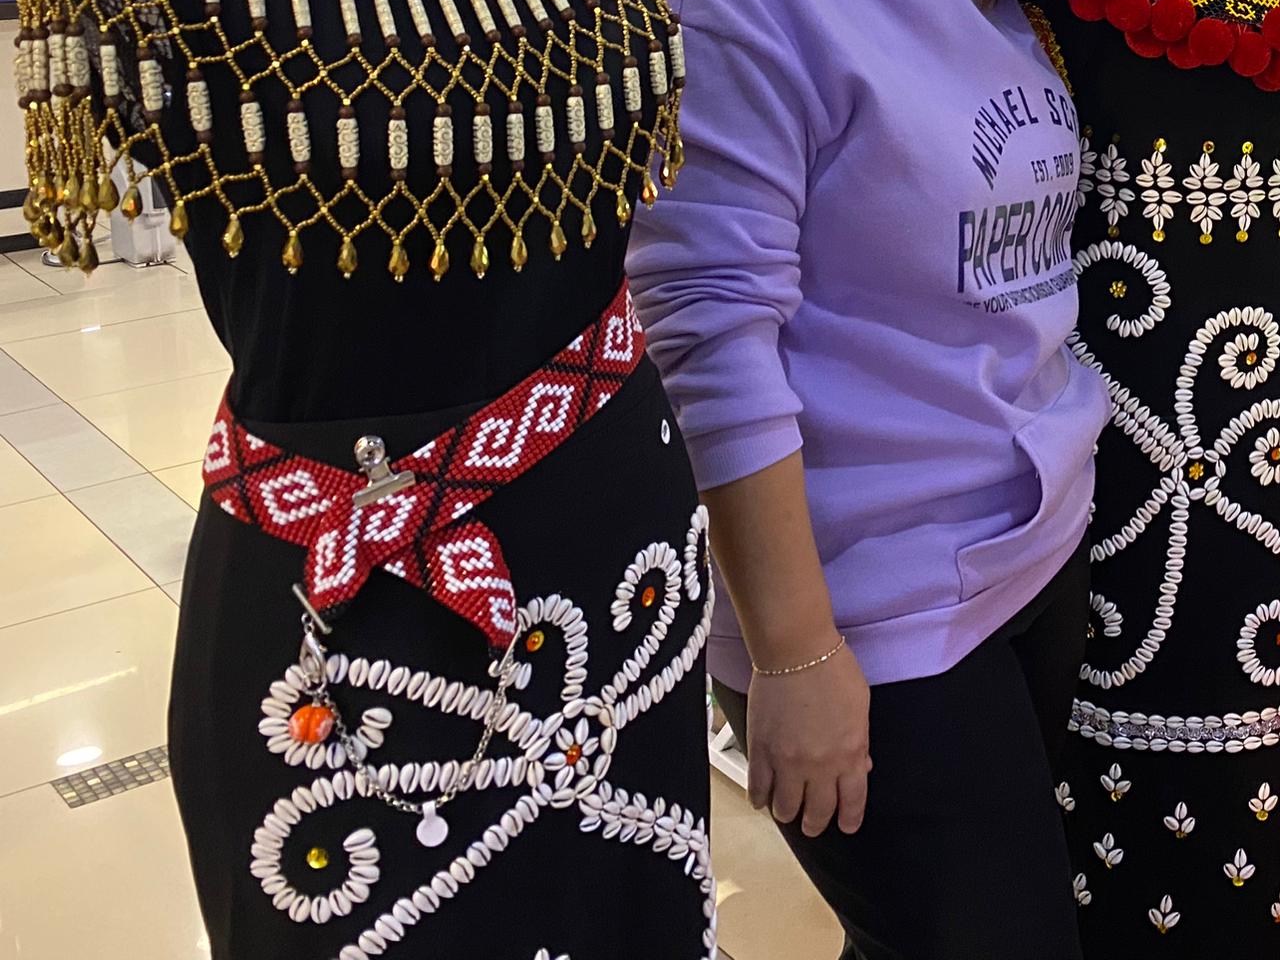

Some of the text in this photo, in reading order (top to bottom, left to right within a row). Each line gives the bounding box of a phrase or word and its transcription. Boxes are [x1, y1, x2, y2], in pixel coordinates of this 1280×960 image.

[972, 86, 1040, 191] MICHAEL
[1031, 152, 1075, 183] EST. 2009
[957, 199, 1036, 294] PAPER
